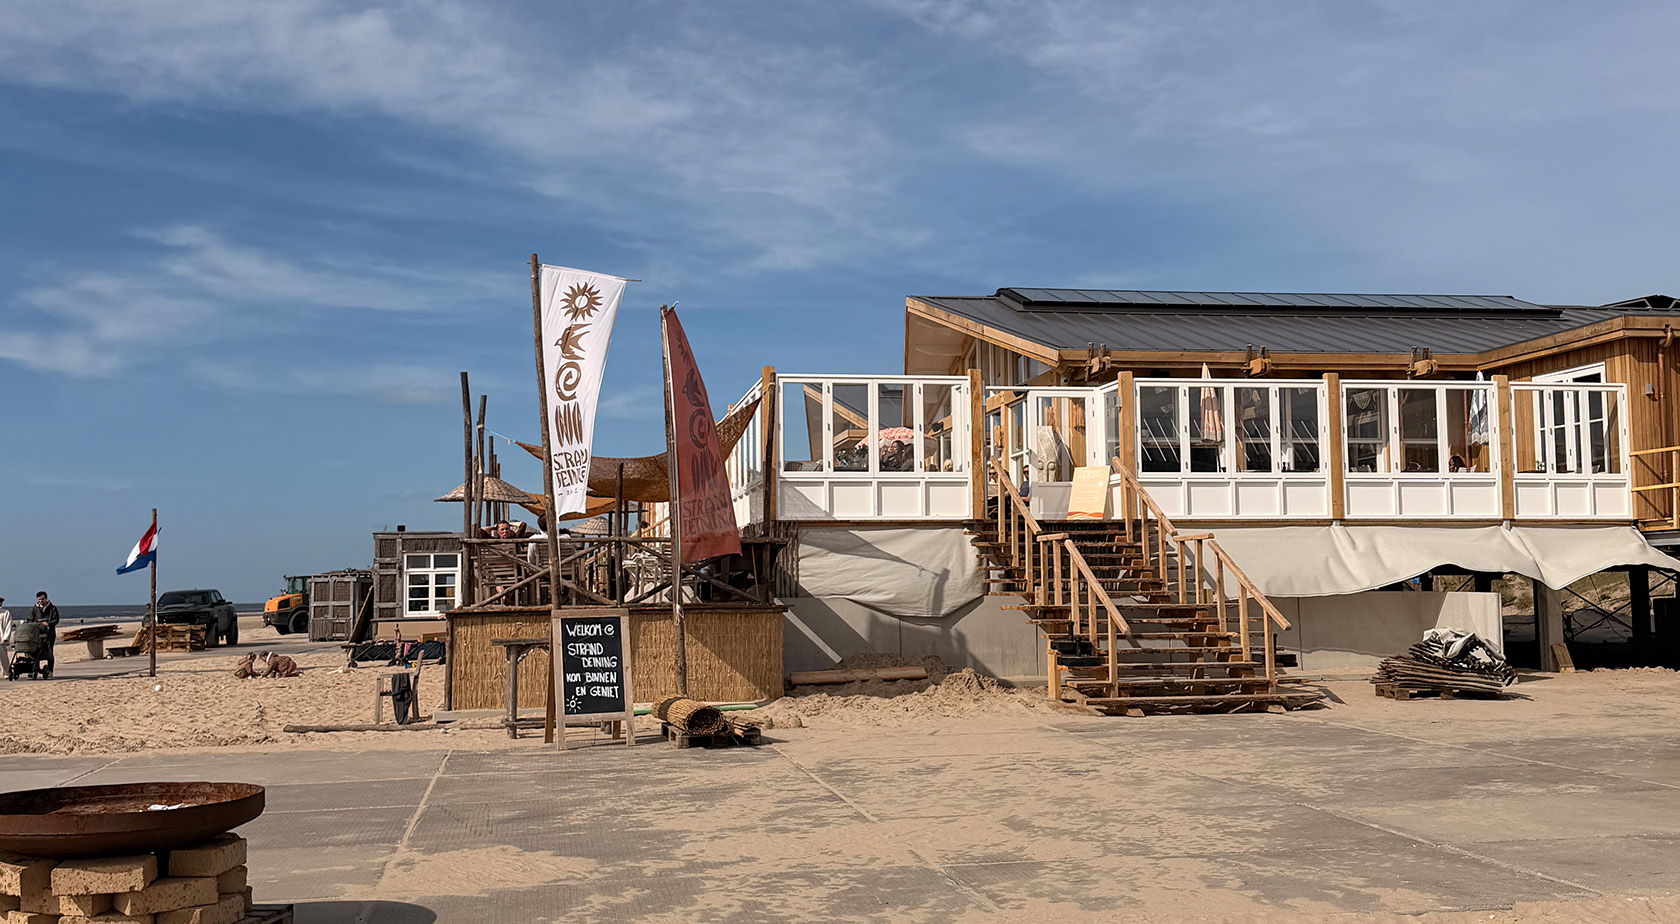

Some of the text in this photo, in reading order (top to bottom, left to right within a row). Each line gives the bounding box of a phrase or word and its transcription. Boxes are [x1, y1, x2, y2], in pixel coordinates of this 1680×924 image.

[682, 493, 732, 518] STRAN
[565, 623, 603, 637] WELKOM
[567, 642, 604, 656] STRAND
[581, 656, 618, 668] DEINING
[585, 671, 617, 684] BINNEN
[575, 686, 619, 699] EN GENIET
